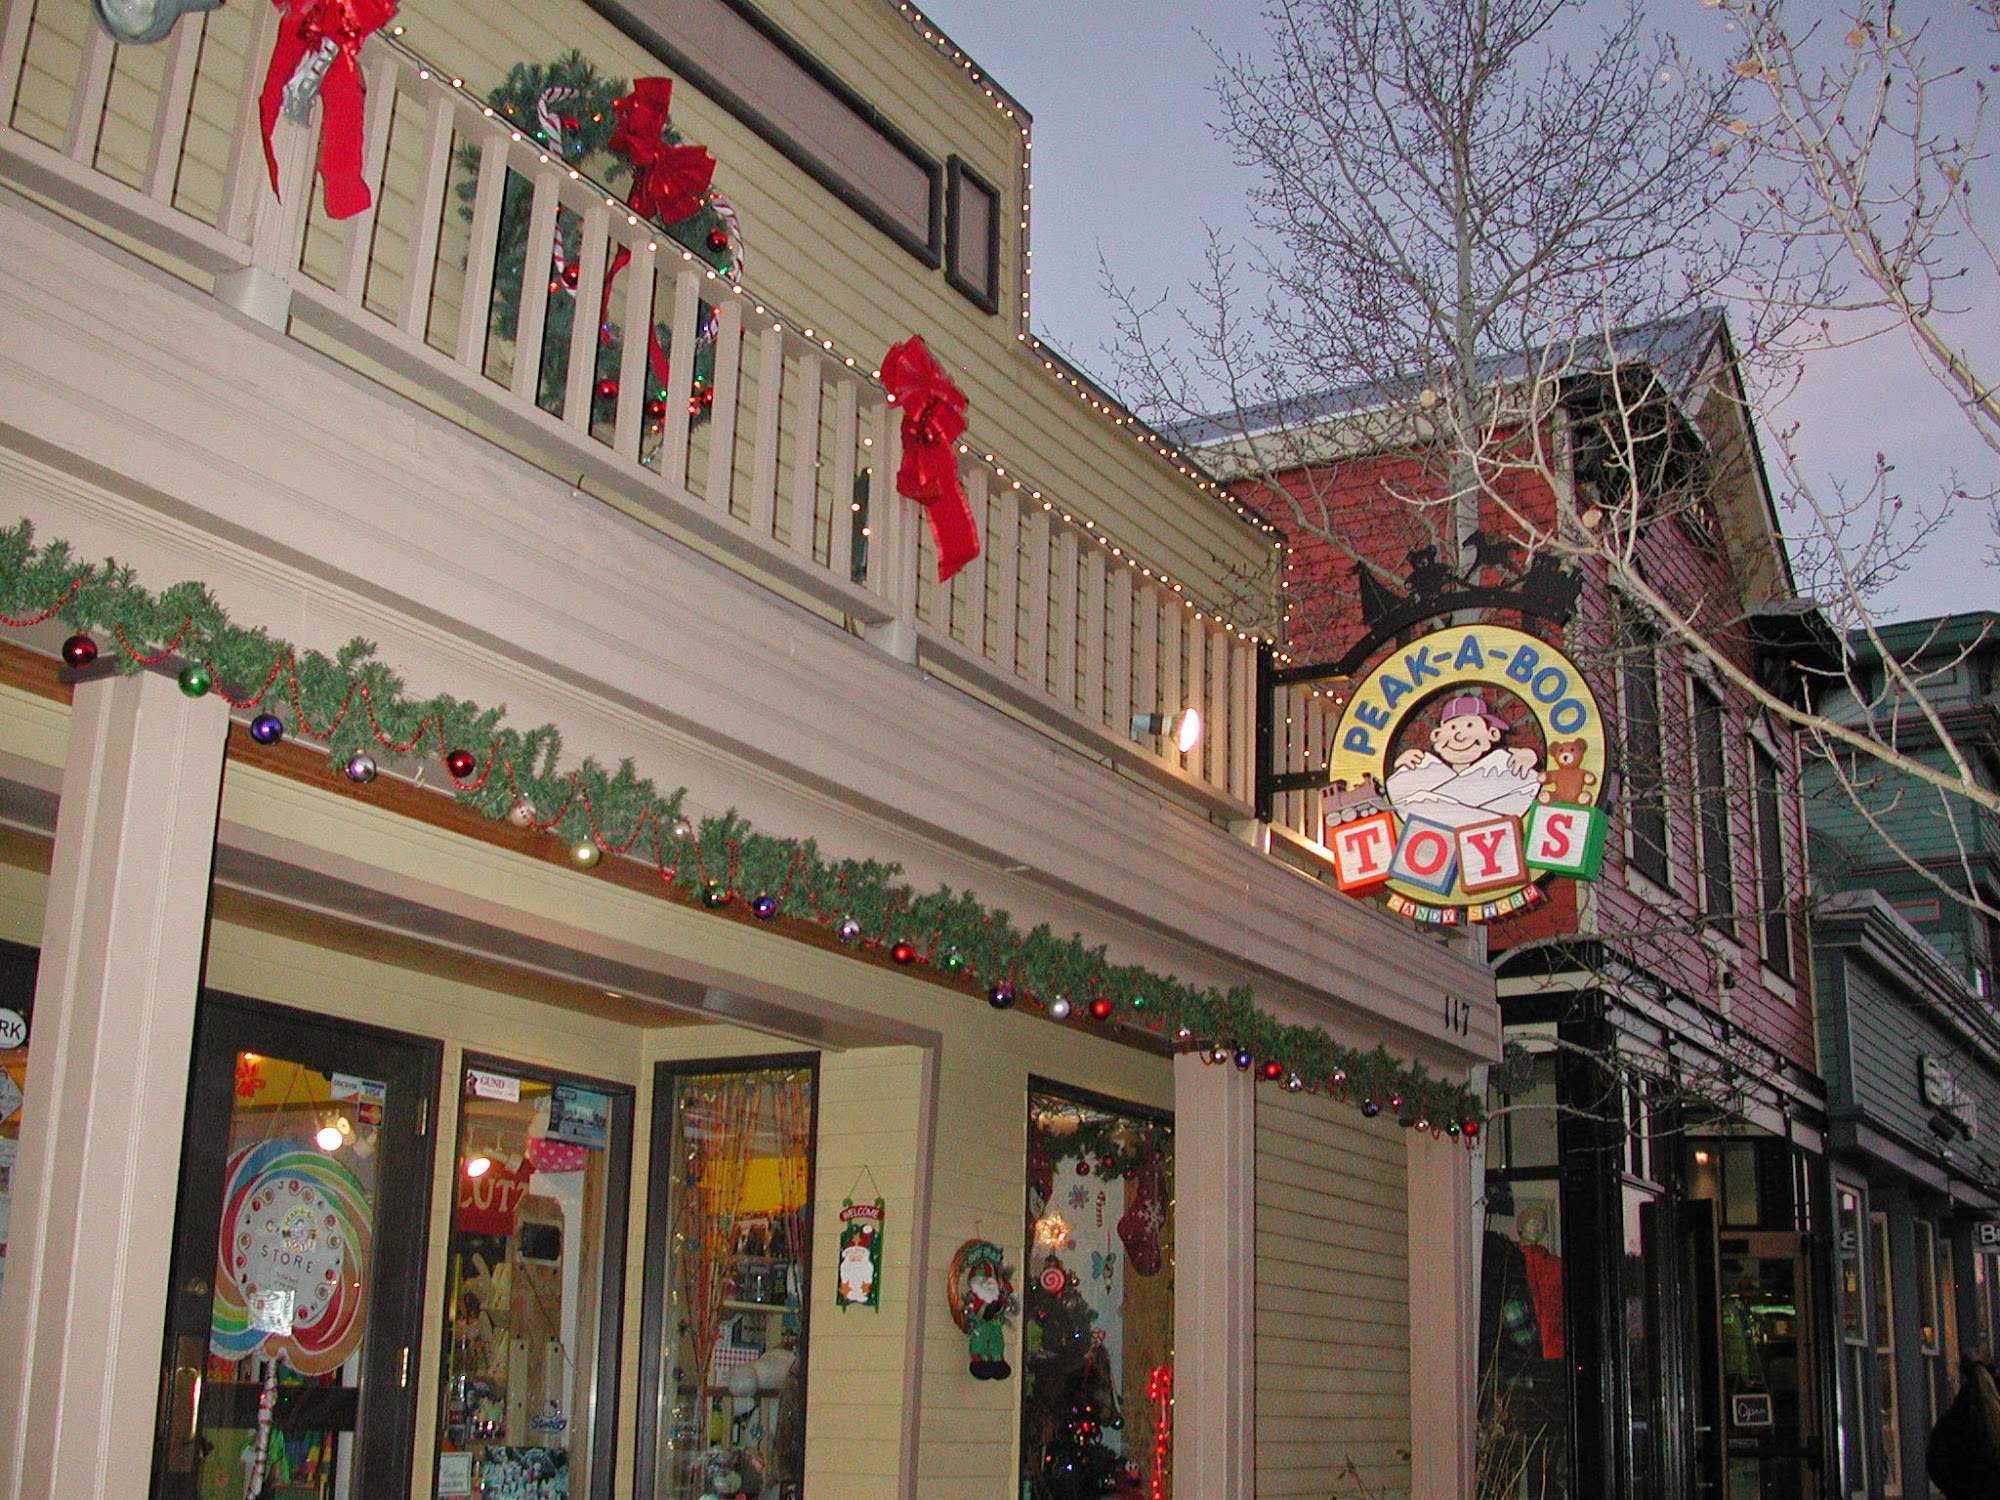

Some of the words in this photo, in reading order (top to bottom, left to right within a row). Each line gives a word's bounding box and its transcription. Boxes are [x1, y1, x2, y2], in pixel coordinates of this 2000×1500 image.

[1343, 635, 1587, 755] PEAK-A-BOO
[1344, 813, 1574, 877] TOYS
[1389, 894, 1456, 924] CANDY
[1470, 886, 1538, 919] STORE
[1445, 995, 1470, 1037] 117
[480, 1075, 505, 1089] GUND
[842, 1206, 880, 1220] WELCOME
[261, 1244, 314, 1274] STORE
